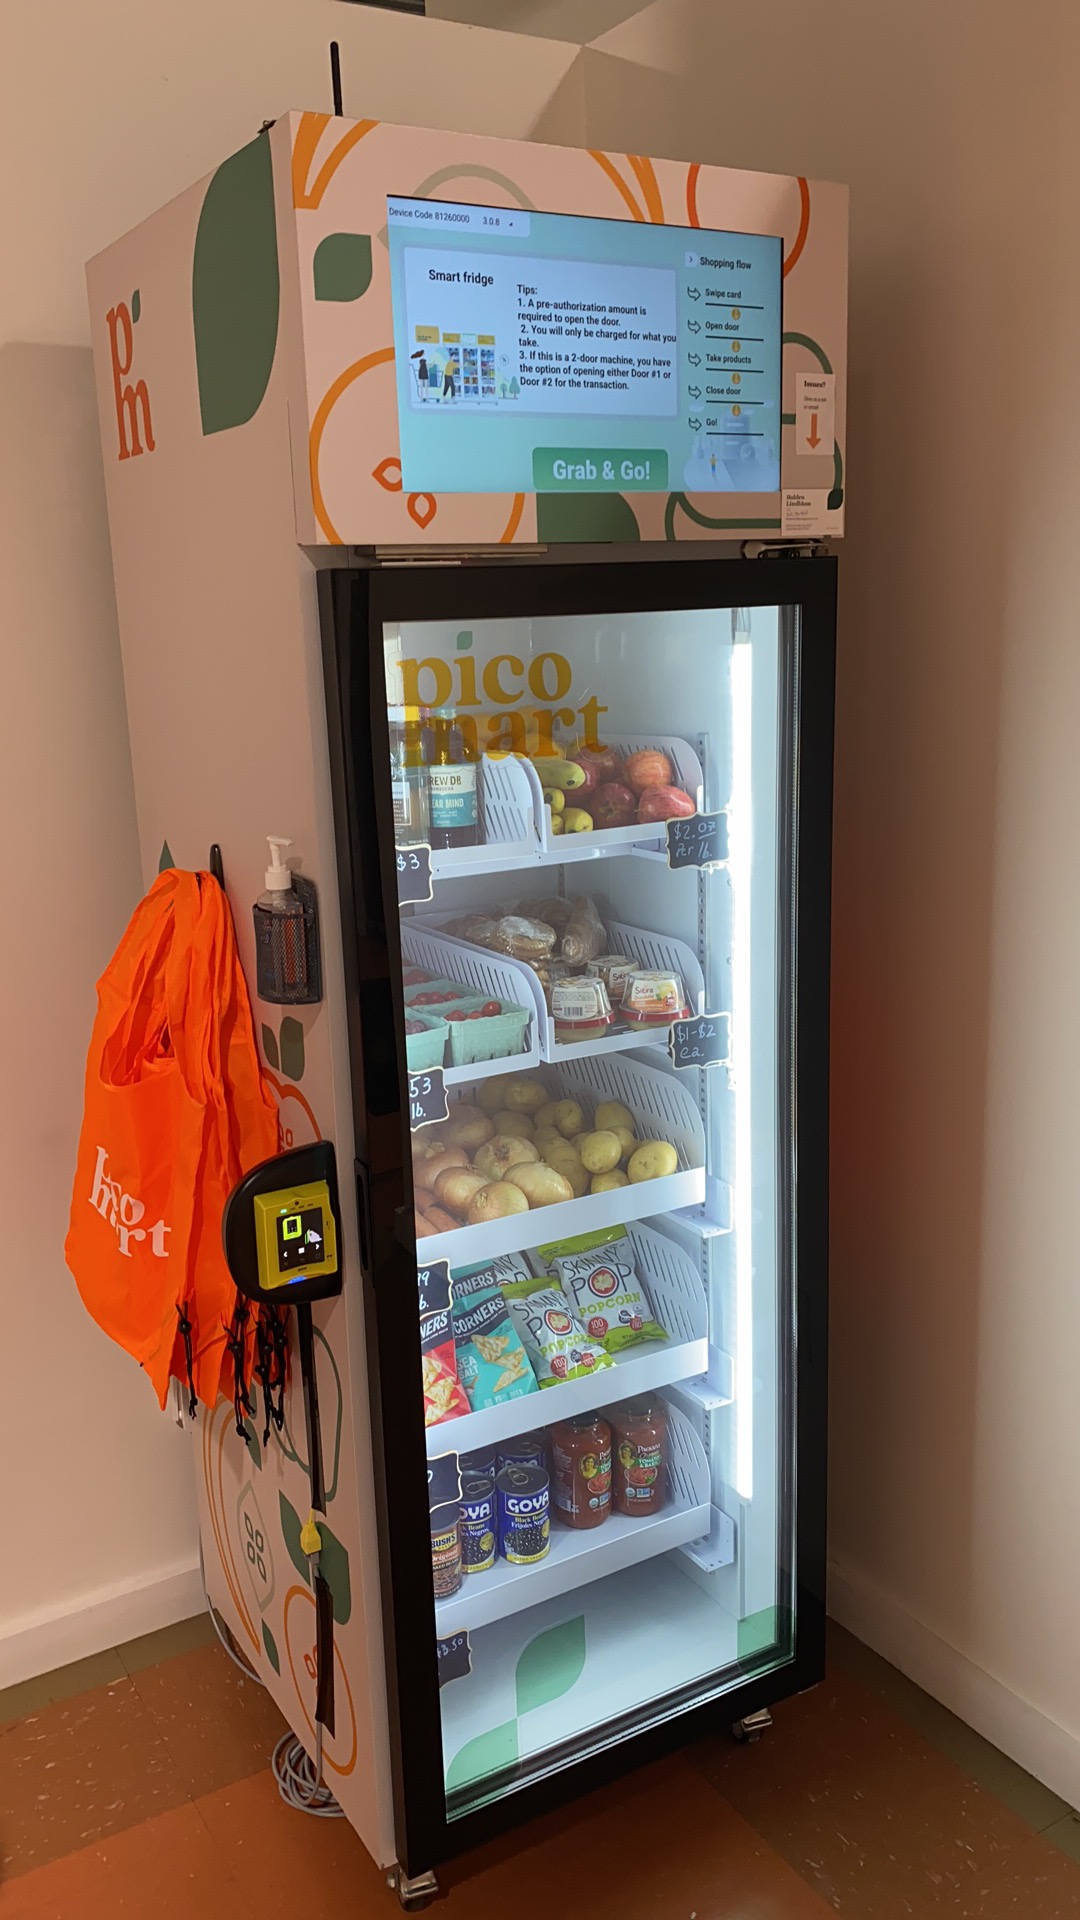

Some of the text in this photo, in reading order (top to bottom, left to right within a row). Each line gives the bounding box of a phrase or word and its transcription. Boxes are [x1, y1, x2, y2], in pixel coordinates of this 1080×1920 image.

[389, 206, 500, 226] Device Code 81260000 3.0.8
[700, 256, 752, 270] Shopping flow
[428, 269, 494, 287] Smart fridge
[517, 284, 538, 296] Tips:
[705, 288, 742, 299] Swipe card
[518, 298, 647, 315] 1. A pre-authorization amount is
[518, 312, 621, 326] required to open the door.
[705, 321, 740, 331] Open door
[520, 324, 677, 344] 2. You will only be charged for what you
[519, 338, 539, 347] take.
[519, 351, 527, 360] 3.
[529, 351, 536, 360] If
[538, 351, 553, 361] this
[555, 352, 563, 361] is
[571, 353, 598, 363] 2-door
[600, 355, 635, 366] machine,
[637, 358, 651, 367] you
[653, 357, 671, 367] have
[706, 354, 752, 364] Take products
[519, 364, 533, 373] the
[535, 365, 561, 375] option
[563, 365, 572, 374] of
[573, 367, 605, 378] opening
[607, 367, 629, 377] either
[631, 368, 650, 378] Door
[651, 369, 660, 378] #1
[520, 376, 630, 390] Door #2 for the transaction.
[706, 386, 741, 395] Close door
[706, 418, 717, 427] Go!
[553, 459, 650, 480] Grab & Go!
[396, 632, 572, 709] pico
[403, 696, 608, 768] mart
[445, 798, 464, 809] MIND
[674, 821, 716, 840] $2.07
[698, 842, 712, 858] lb.
[635, 986, 654, 995] Sabra
[677, 1022, 716, 1044] $1-$2
[680, 1047, 704, 1059] ea.
[562, 1246, 620, 1279] SKINNY
[570, 1262, 632, 1306] POP
[578, 1292, 641, 1318] POPCORN
[452, 1297, 505, 1334] CORNERS
[591, 1318, 604, 1329] 100
[457, 1355, 478, 1371] SEA
[553, 1357, 567, 1368] 100
[459, 1364, 479, 1379] SALT
[508, 1491, 549, 1513] GOYA
